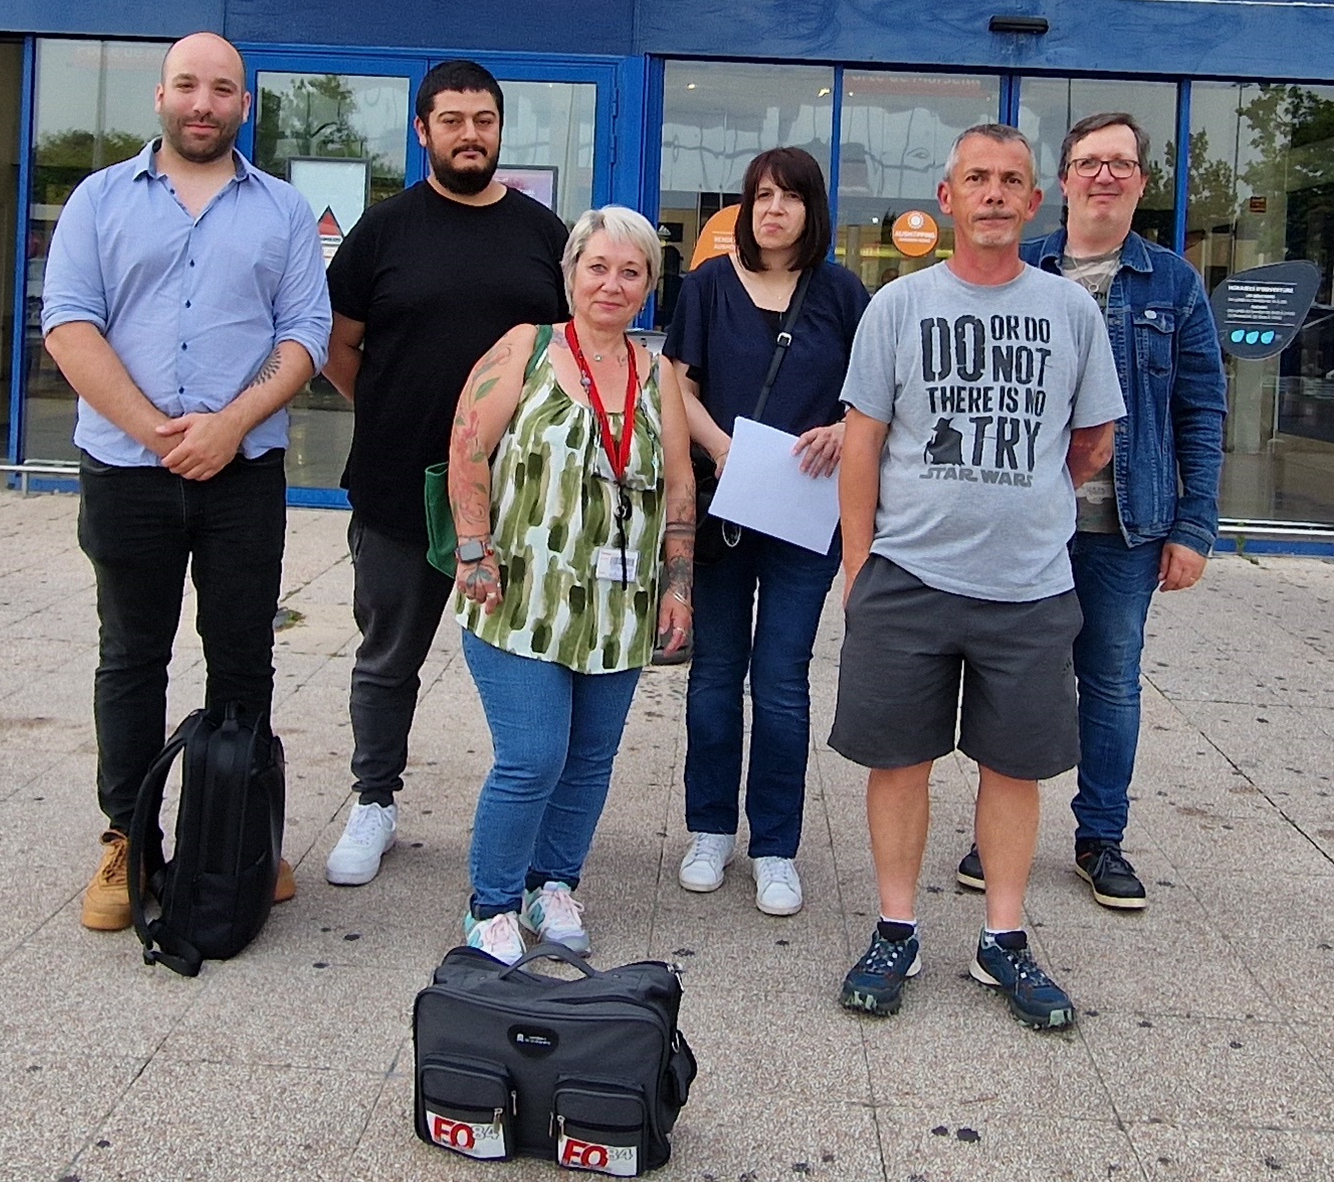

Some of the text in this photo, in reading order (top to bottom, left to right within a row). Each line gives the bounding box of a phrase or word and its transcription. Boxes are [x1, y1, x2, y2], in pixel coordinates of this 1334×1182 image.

[920, 314, 1051, 382] DO OR DO
[991, 345, 1052, 387] NOT
[925, 385, 1047, 417] THERE IS NO
[969, 415, 1042, 472] TRY
[919, 467, 1034, 488] STAR WARS
